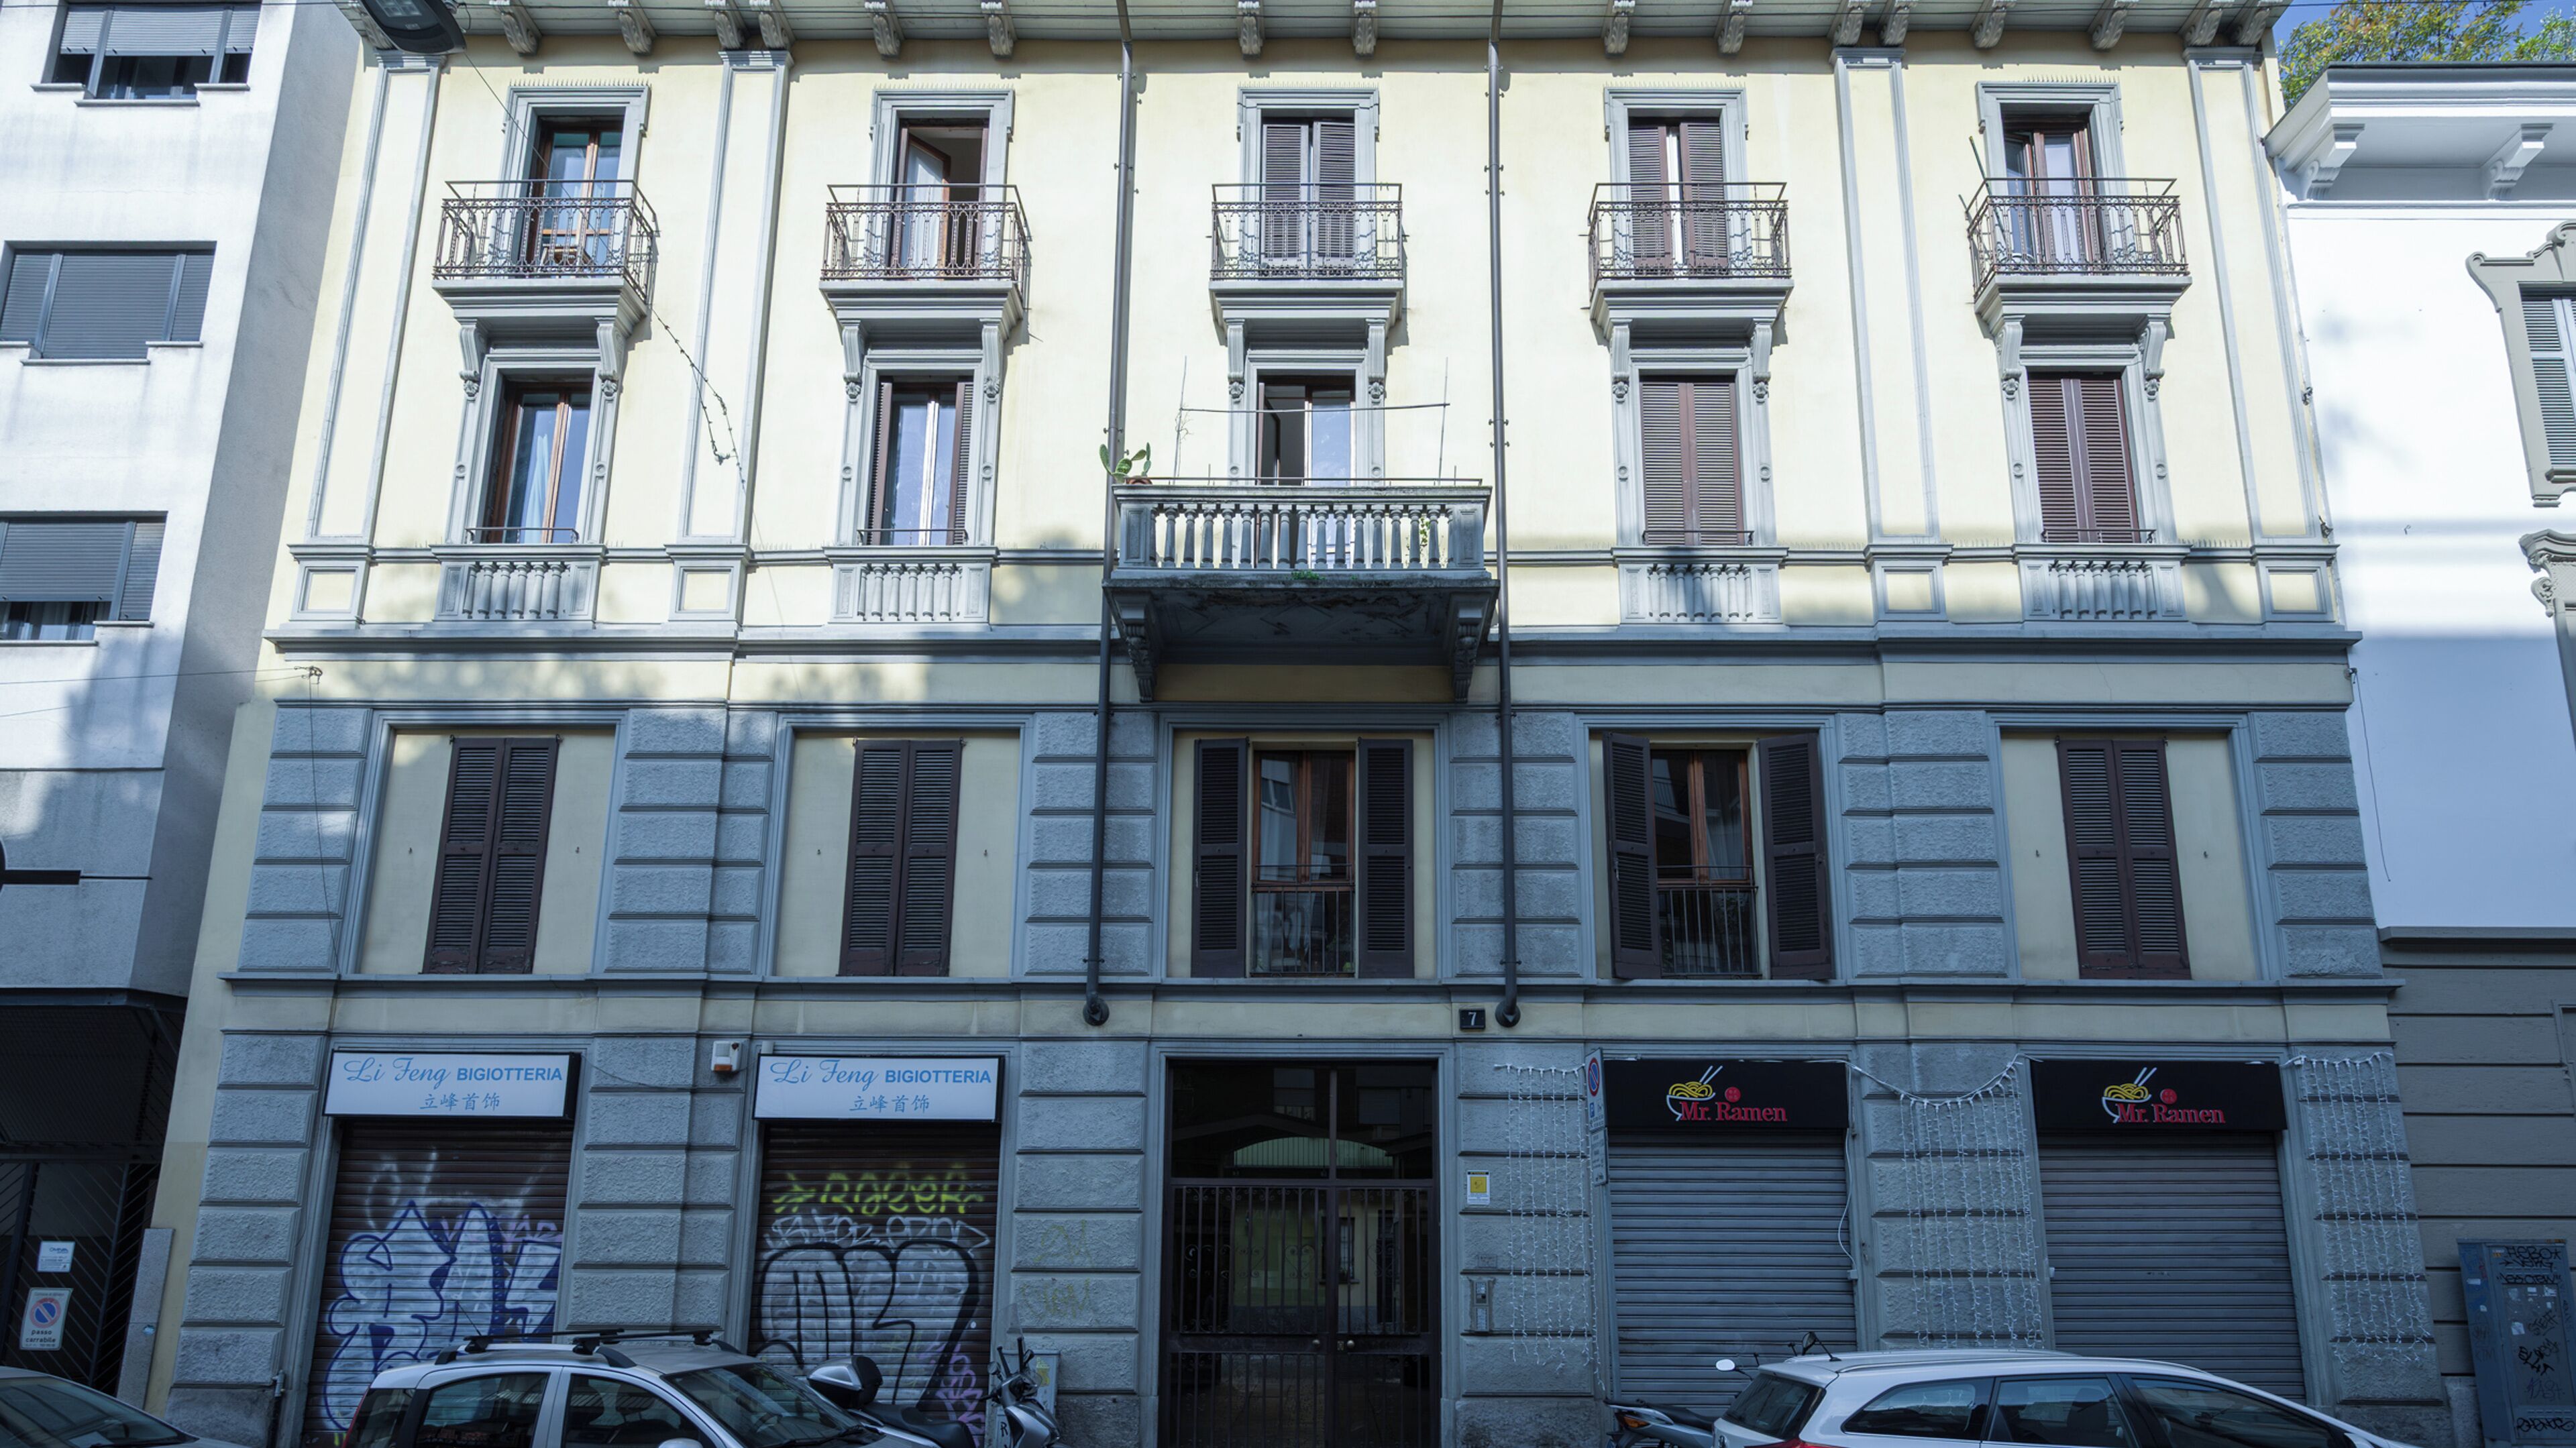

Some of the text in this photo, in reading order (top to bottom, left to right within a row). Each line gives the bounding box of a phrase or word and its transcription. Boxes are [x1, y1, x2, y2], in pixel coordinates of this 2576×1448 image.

[1468, 1011, 1477, 1026] 7
[343, 1056, 563, 1089] Li Feng BIGIOTTERIA
[769, 1058, 991, 1091] Li Feng BIGIOTTERIA
[419, 1093, 500, 1111] 立峰首饰
[849, 1095, 930, 1113] 立峰首饰
[1679, 1101, 1788, 1122] Mr. Ramen
[2115, 1103, 2226, 1125] Mr. Ramen
